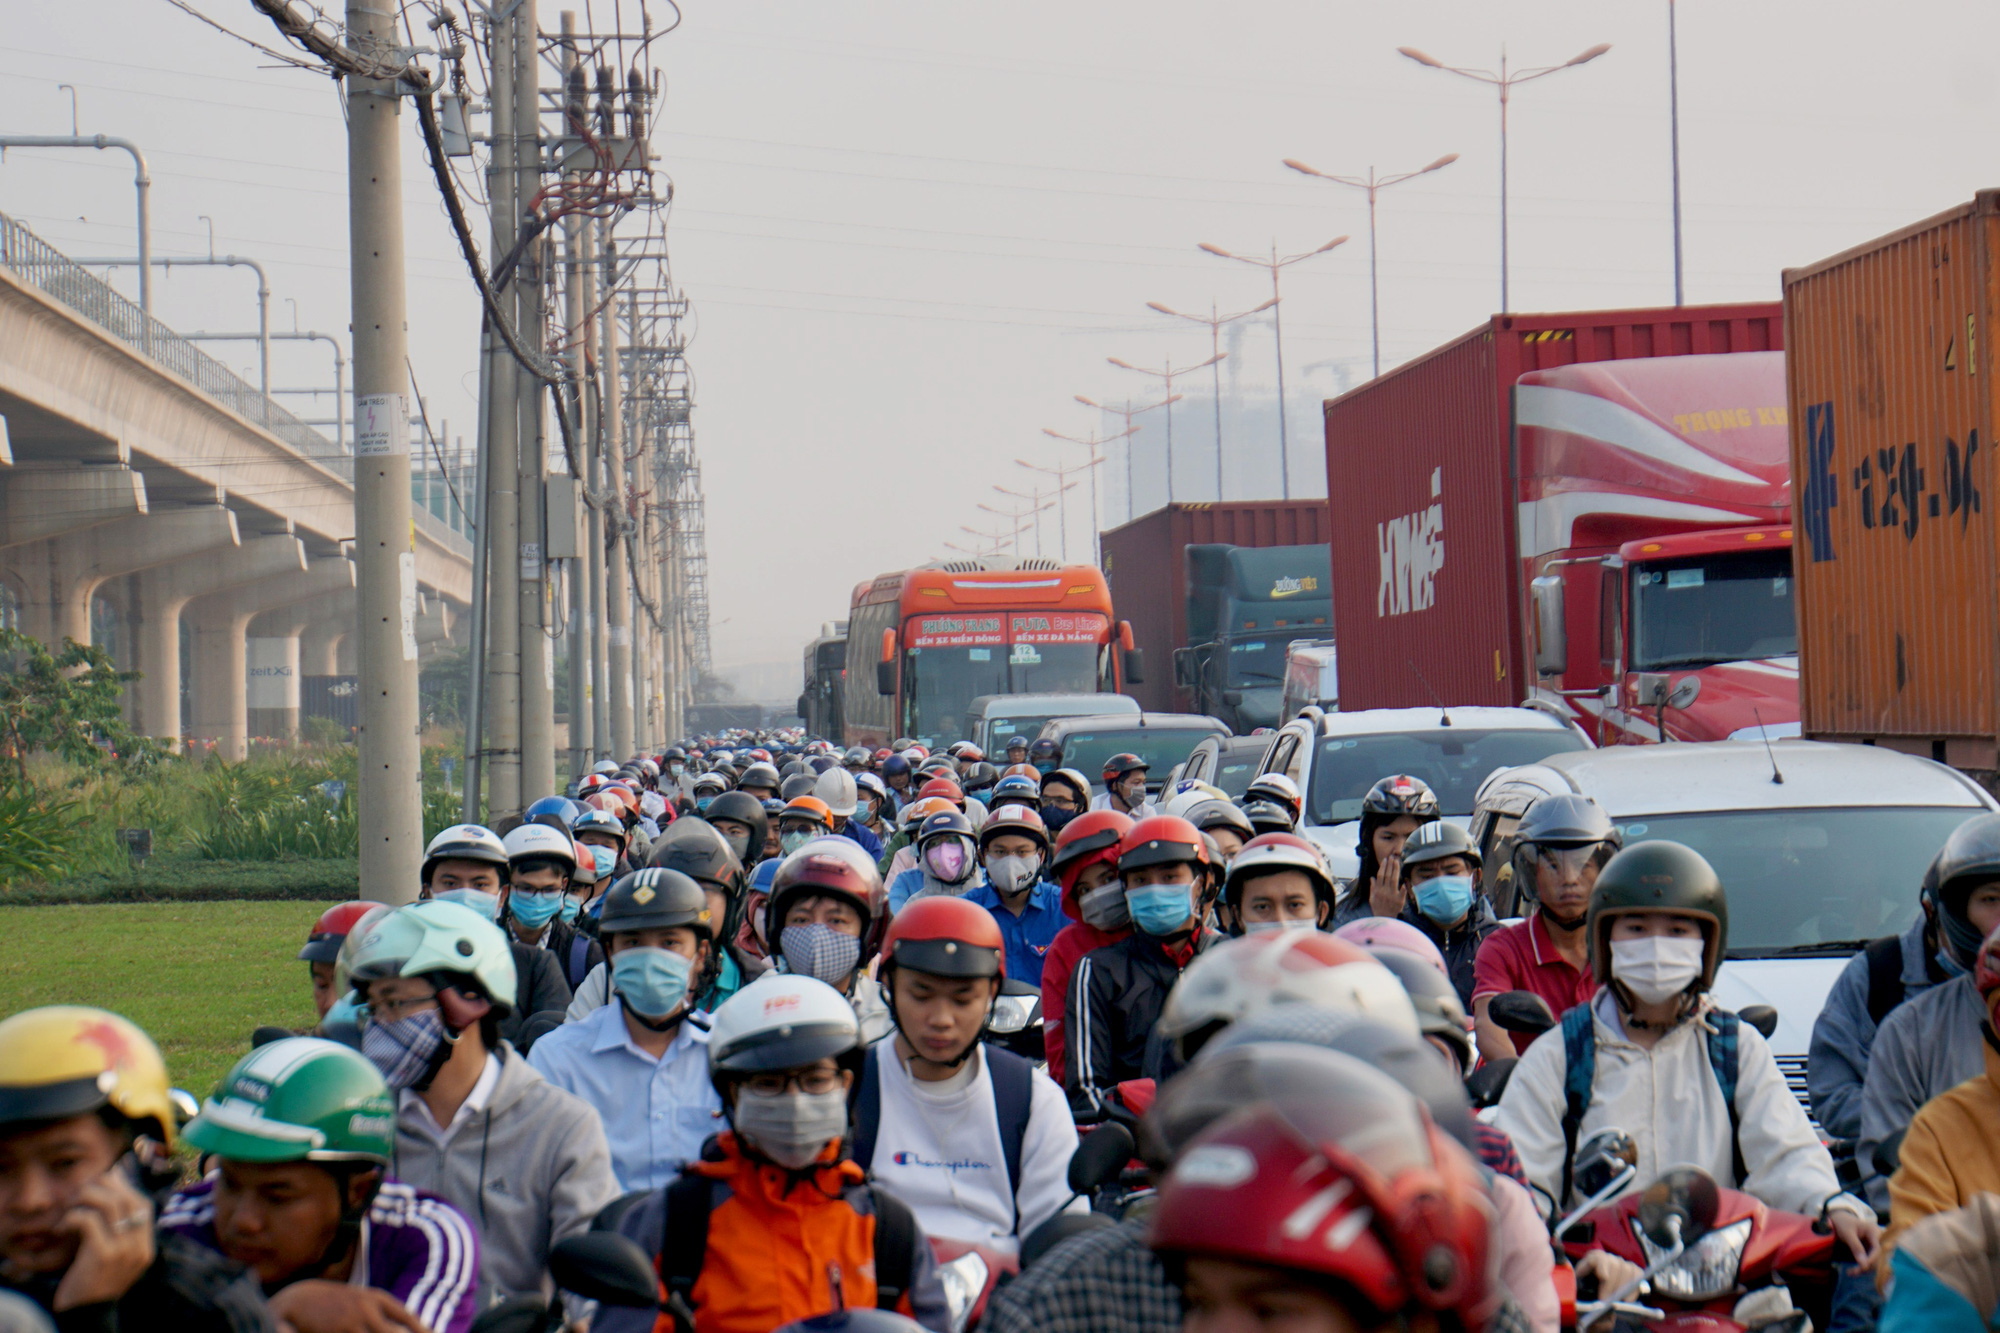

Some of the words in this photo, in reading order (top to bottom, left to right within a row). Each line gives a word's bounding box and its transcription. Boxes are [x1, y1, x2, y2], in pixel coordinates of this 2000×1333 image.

[965, 618, 1000, 632] TRANG
[1013, 617, 1050, 631] FUTA
[1053, 617, 1073, 631] Bus
[1076, 617, 1101, 631] Lines
[915, 635, 934, 646] BẾN
[936, 636, 948, 645] XE
[1016, 631, 1035, 641] BẾN
[1037, 633, 1049, 641] XE
[1018, 646, 1031, 655] 12
[1016, 871, 1033, 885] FILA
[892, 1151, 992, 1174] Champion
